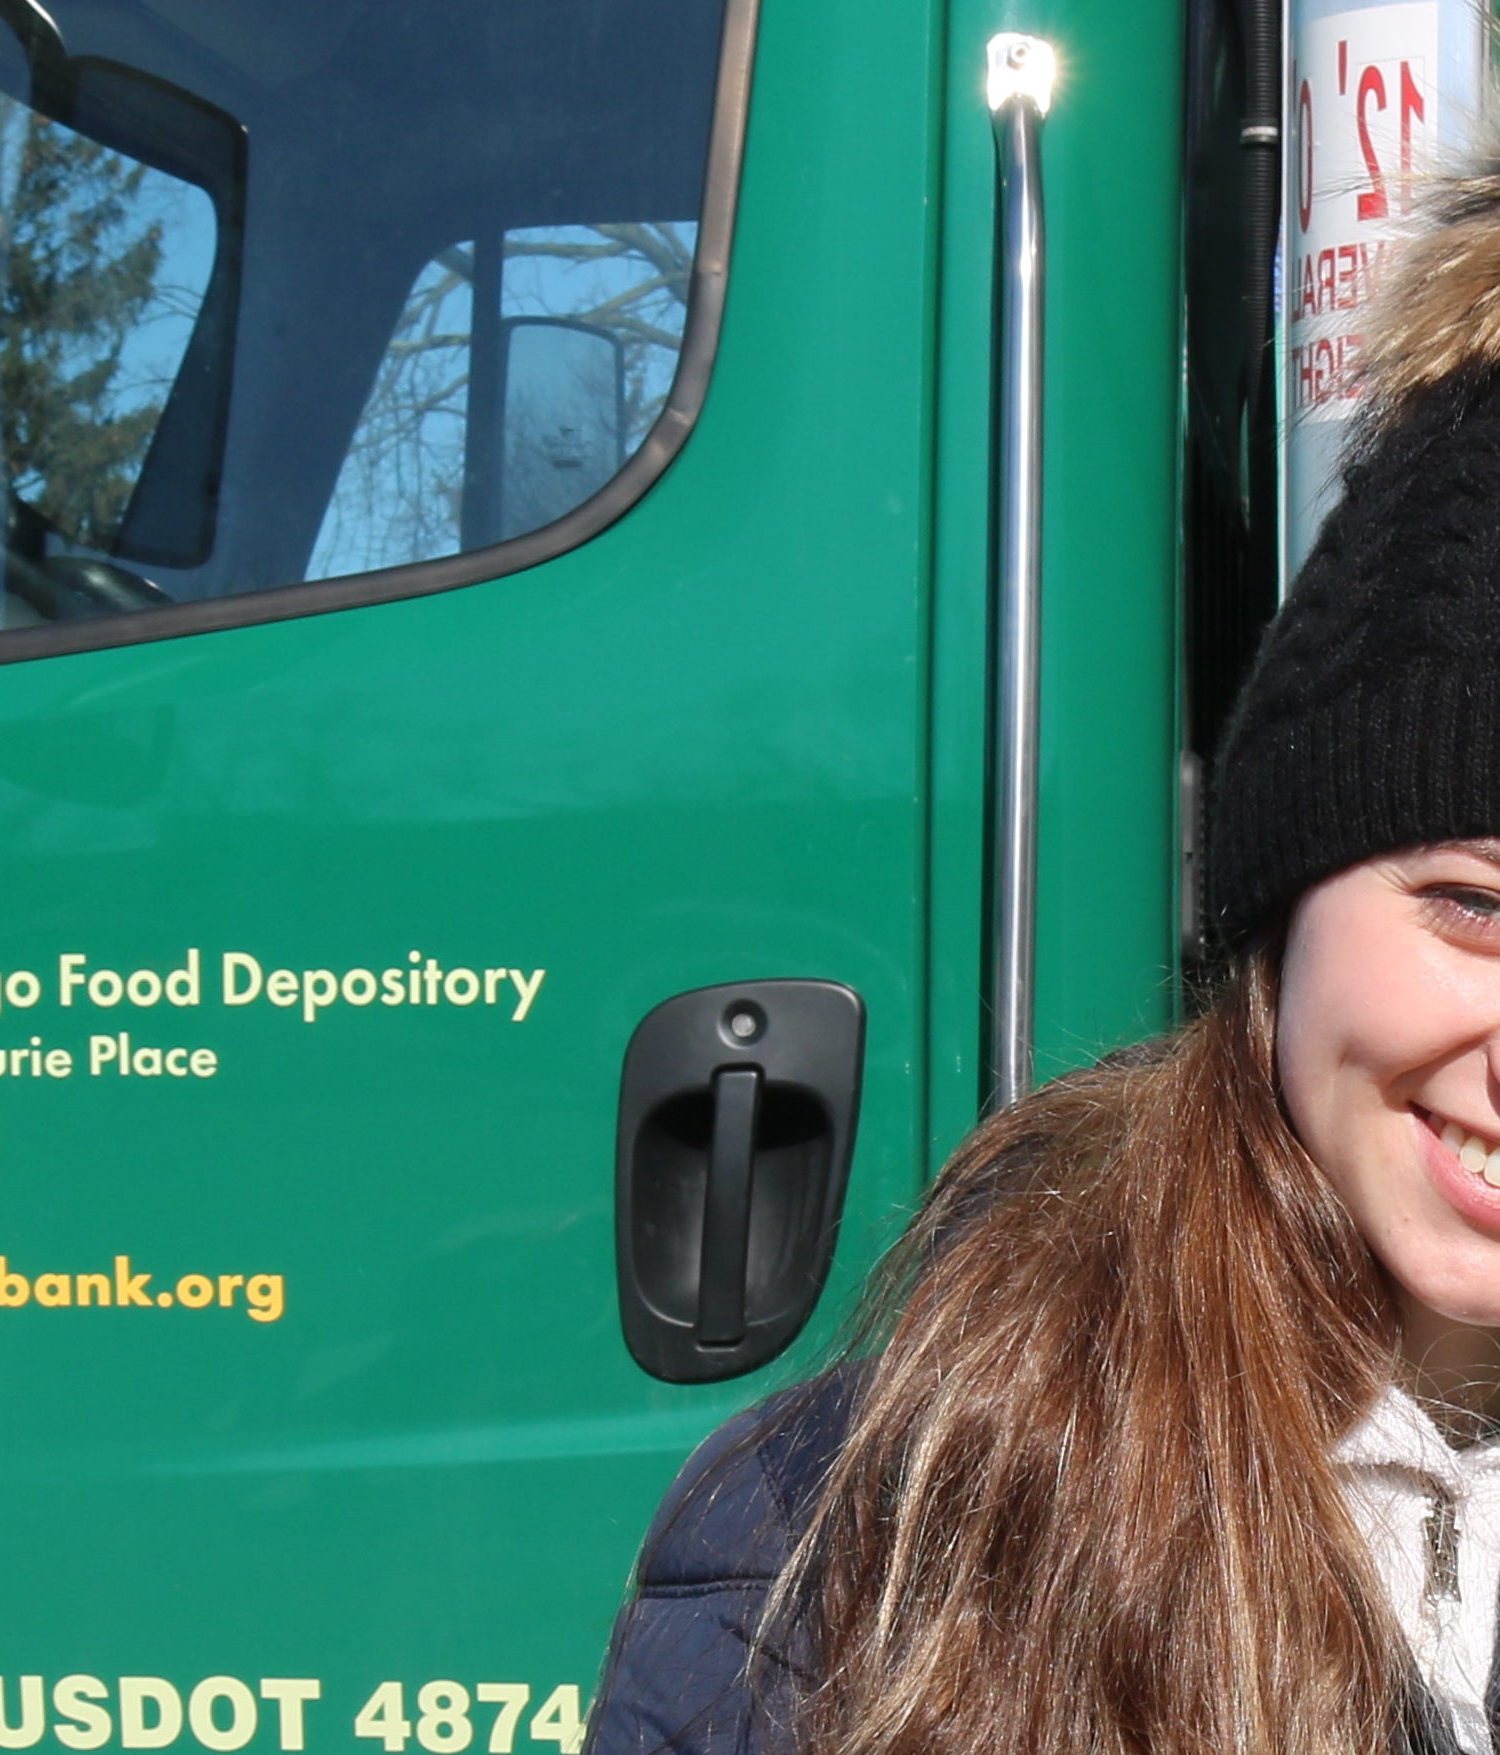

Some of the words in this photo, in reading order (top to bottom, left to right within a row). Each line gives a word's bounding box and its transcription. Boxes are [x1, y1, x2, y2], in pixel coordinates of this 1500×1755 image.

[60, 948, 202, 1009] Food
[223, 951, 547, 1023] Depository
[90, 1032, 219, 1079] Place
[355, 1680, 592, 1755] 4874
